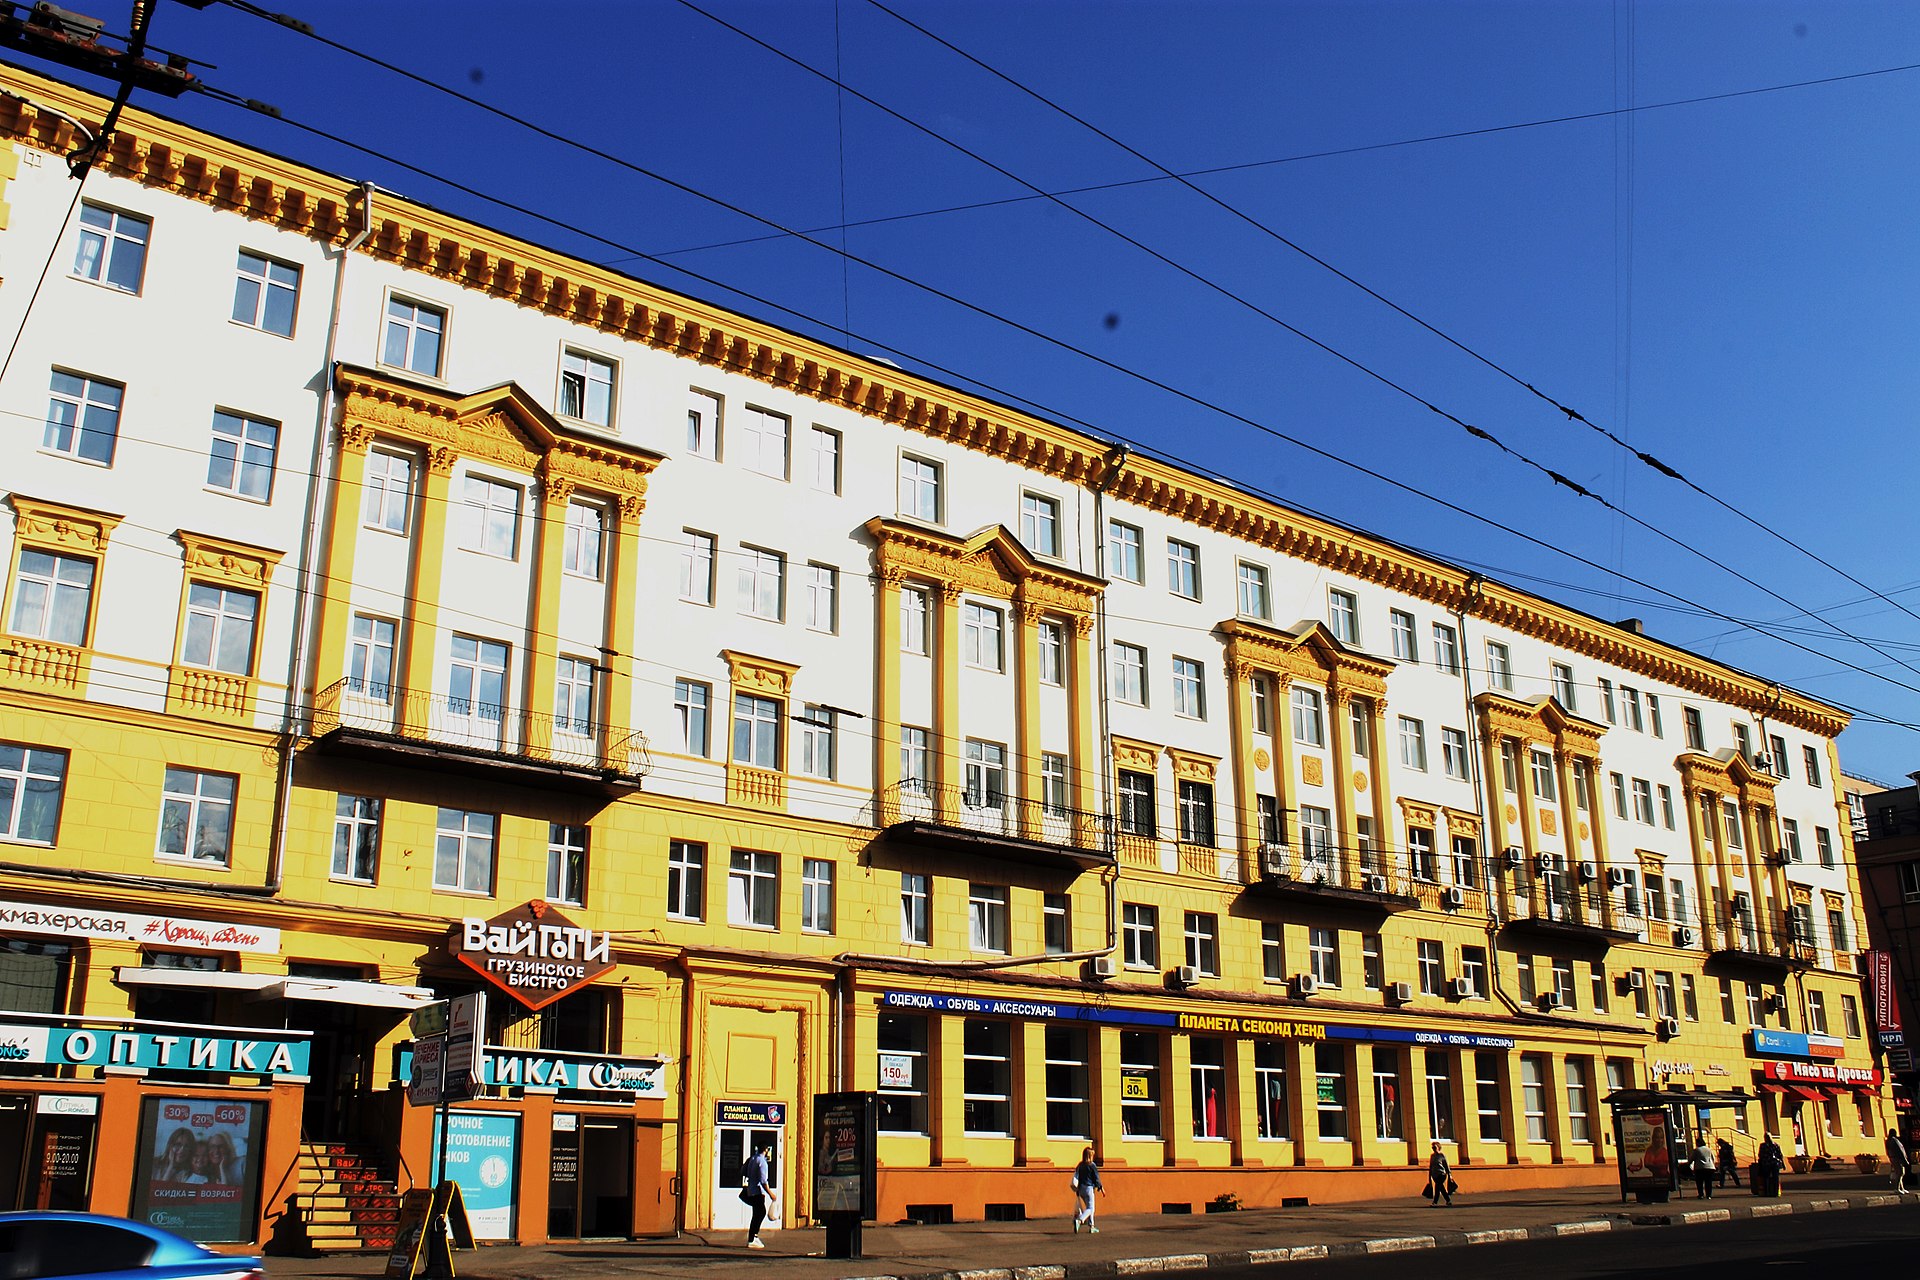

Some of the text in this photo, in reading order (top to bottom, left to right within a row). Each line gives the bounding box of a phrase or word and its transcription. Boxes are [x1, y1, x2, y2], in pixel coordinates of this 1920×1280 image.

[487, 958, 585, 978] ГРУЗИНСКОЕ
[508, 973, 568, 990] БИСТРО
[1879, 963, 1888, 1027] ТИПОГРАФИЯ
[889, 993, 1056, 1017] ОДЕЖДА ОБУВЬ АКСЕССУАРЫ
[1179, 1013, 1326, 1039] ПЛАНЕТА СЕКОНД ХЕНД
[1415, 1033, 1514, 1048] ОДЕЖДА ОБУВЬ АКСЕССУАРЫ
[63, 1031, 294, 1072] ОПТИКА
[481, 1055, 569, 1086] ТИКА
[884, 1067, 901, 1079] 150
[1792, 1062, 1873, 1084] Мясо на Дровах
[165, 1107, 189, 1117] -30%
[217, 1109, 245, 1120] -60%
[724, 1105, 752, 1113] ПЛАНЕТА
[724, 1112, 765, 1122] СЕКОНД ХЕНД
[154, 1189, 186, 1198] СКИДКА
[200, 1190, 236, 1198] ВОЗРАСТ
